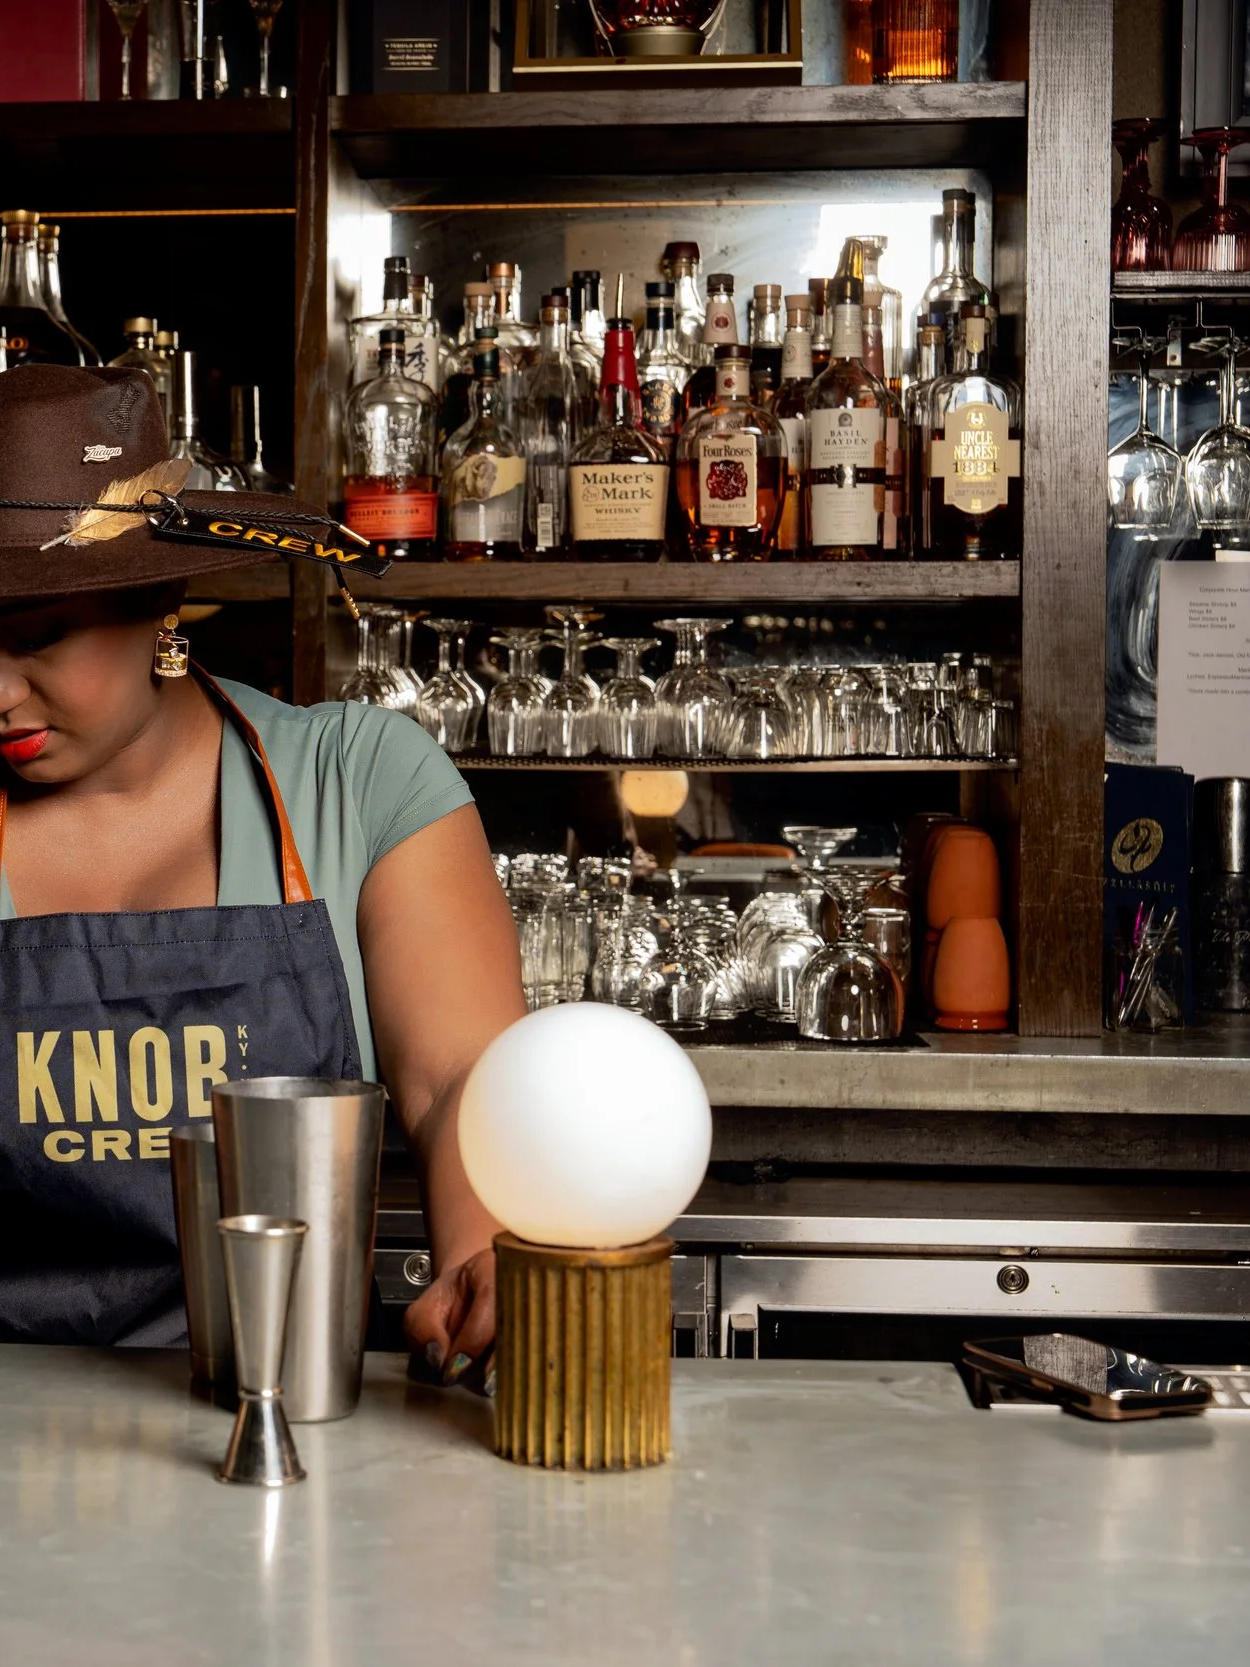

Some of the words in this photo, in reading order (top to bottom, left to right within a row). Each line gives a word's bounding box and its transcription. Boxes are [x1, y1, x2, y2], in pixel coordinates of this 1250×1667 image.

[960, 431, 994, 446] UNCLE
[703, 445, 724, 457] Four
[724, 445, 753, 457] Roses
[954, 446, 999, 460] NEAREST
[582, 471, 654, 485] Maker's
[601, 487, 652, 500] Mark
[595, 507, 642, 515] WHISKY
[208, 521, 362, 563] CREW
[17, 1025, 229, 1124] KNOB
[43, 1126, 173, 1163] CRE
